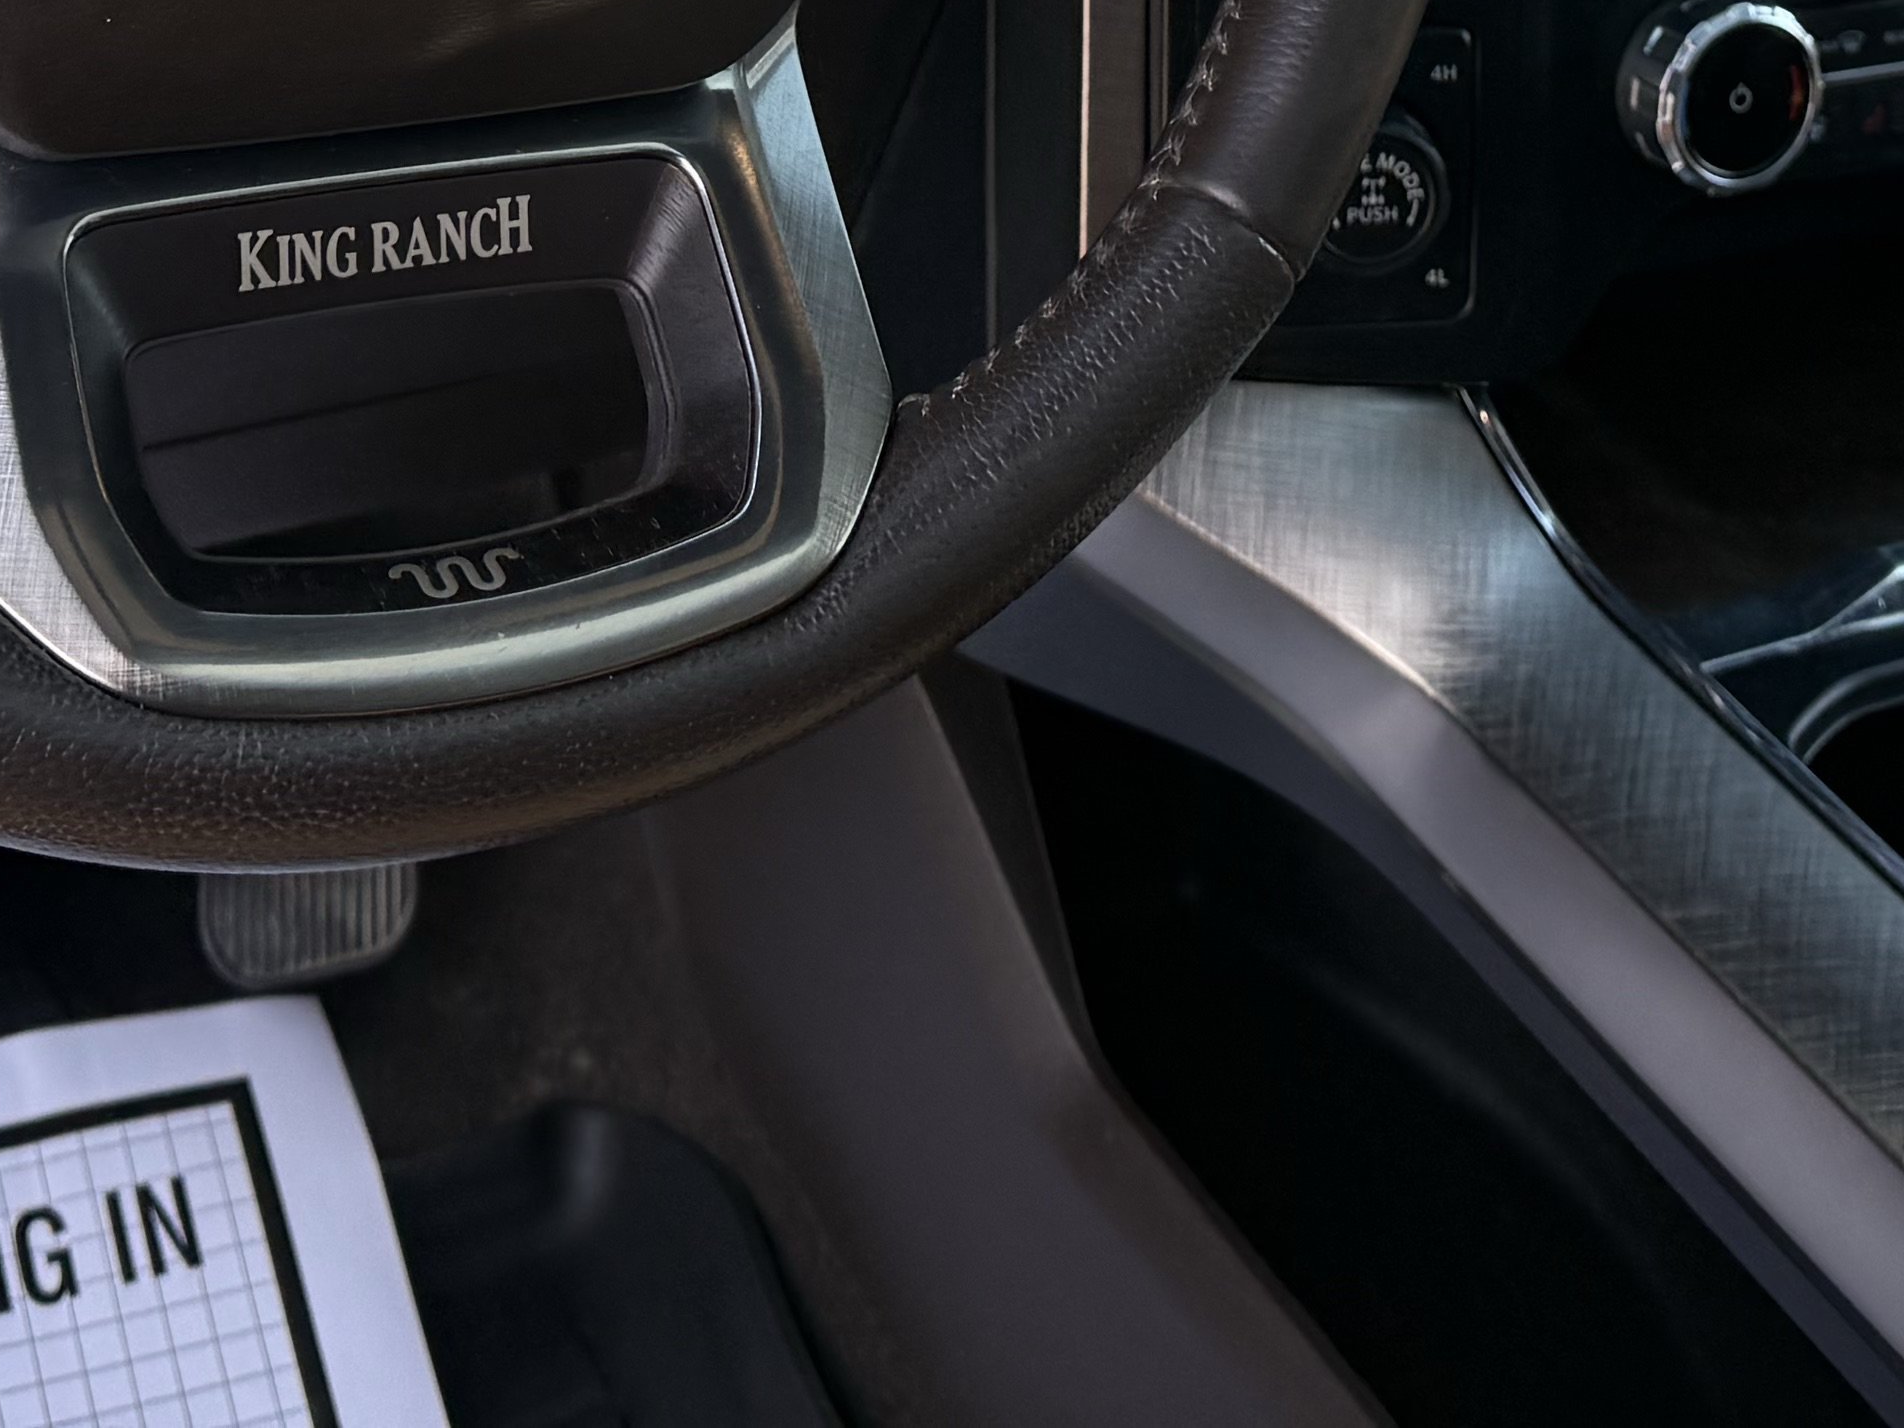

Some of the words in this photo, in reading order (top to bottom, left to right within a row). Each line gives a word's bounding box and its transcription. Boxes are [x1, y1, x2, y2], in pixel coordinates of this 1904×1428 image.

[1431, 64, 1458, 81] 4H
[1377, 152, 1424, 203] MODE
[1347, 205, 1399, 225] PUSH
[237, 226, 359, 294] KING
[372, 194, 533, 271] RANCH
[103, 1175, 205, 1285] IN
